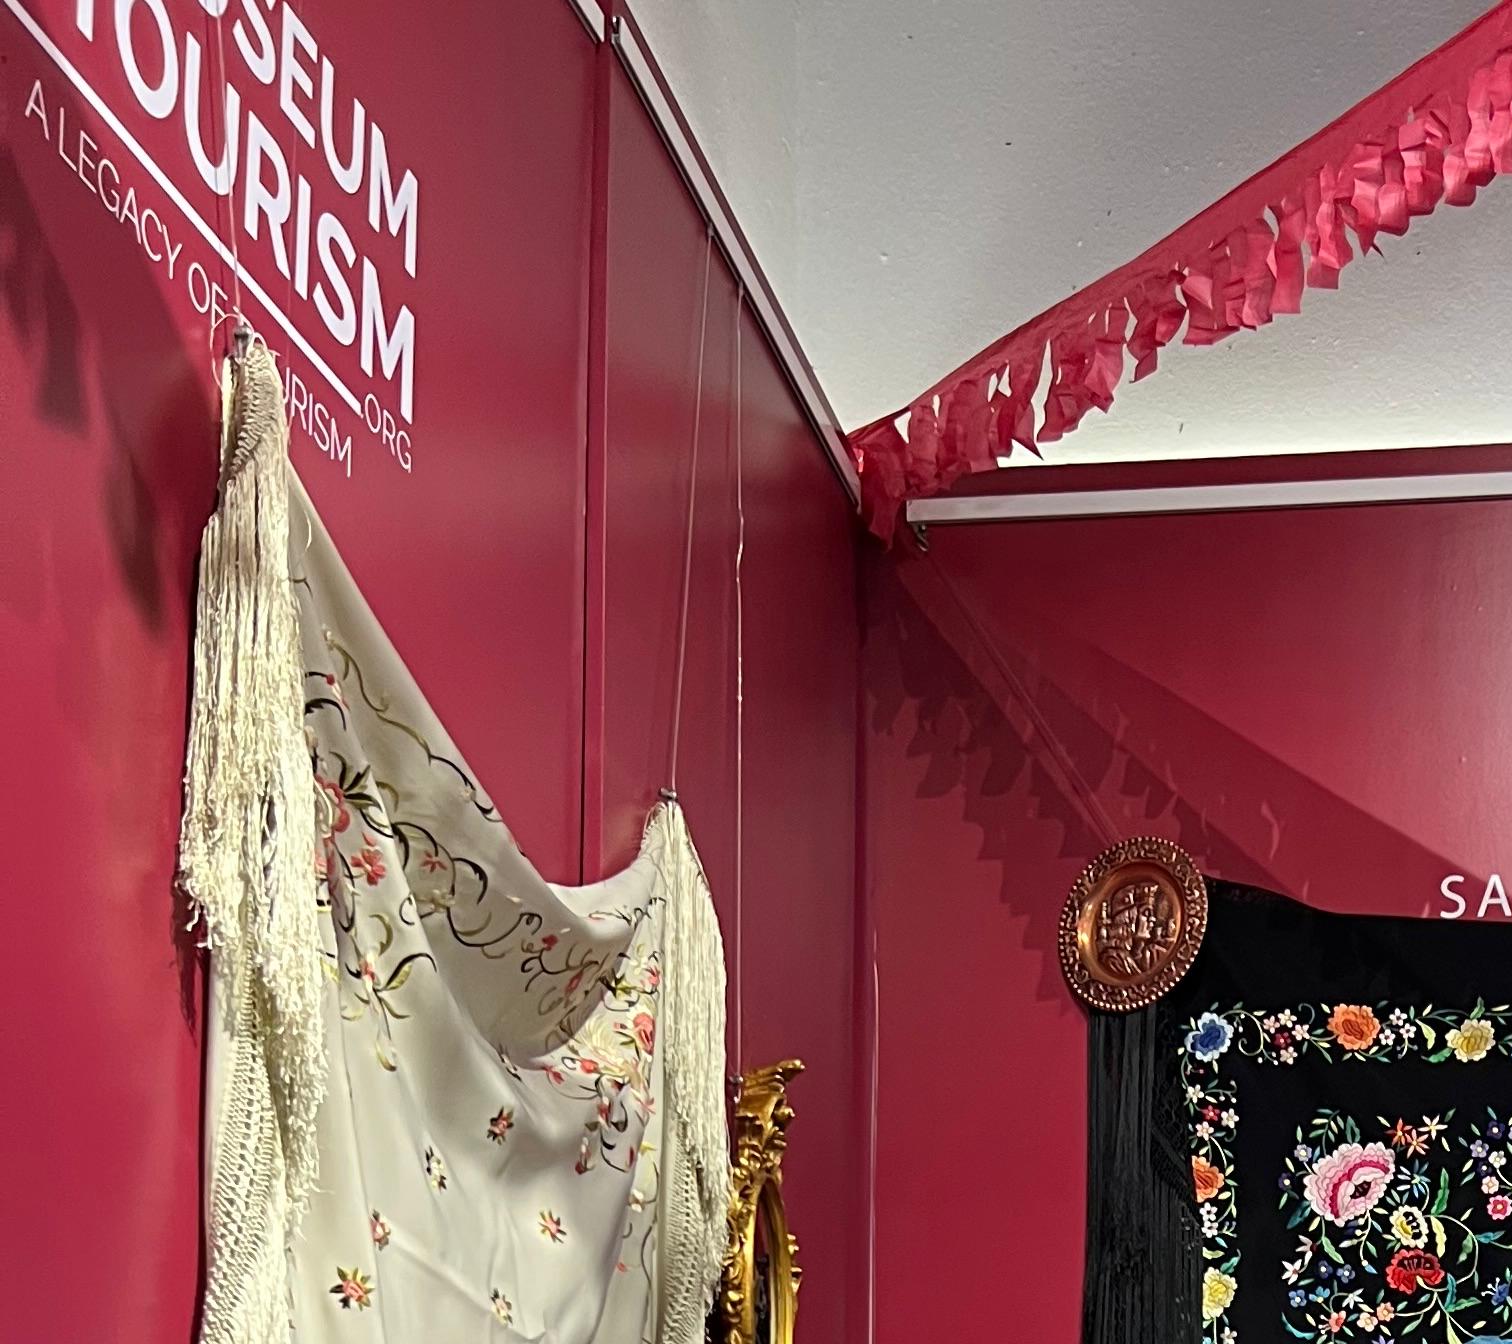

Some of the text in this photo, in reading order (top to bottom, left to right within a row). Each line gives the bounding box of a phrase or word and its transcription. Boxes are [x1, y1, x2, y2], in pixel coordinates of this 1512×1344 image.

[24, 79, 50, 140] A
[58, 107, 183, 280] LEGACY
[187, 262, 229, 330] OF
[204, 0, 418, 278] SEUM
